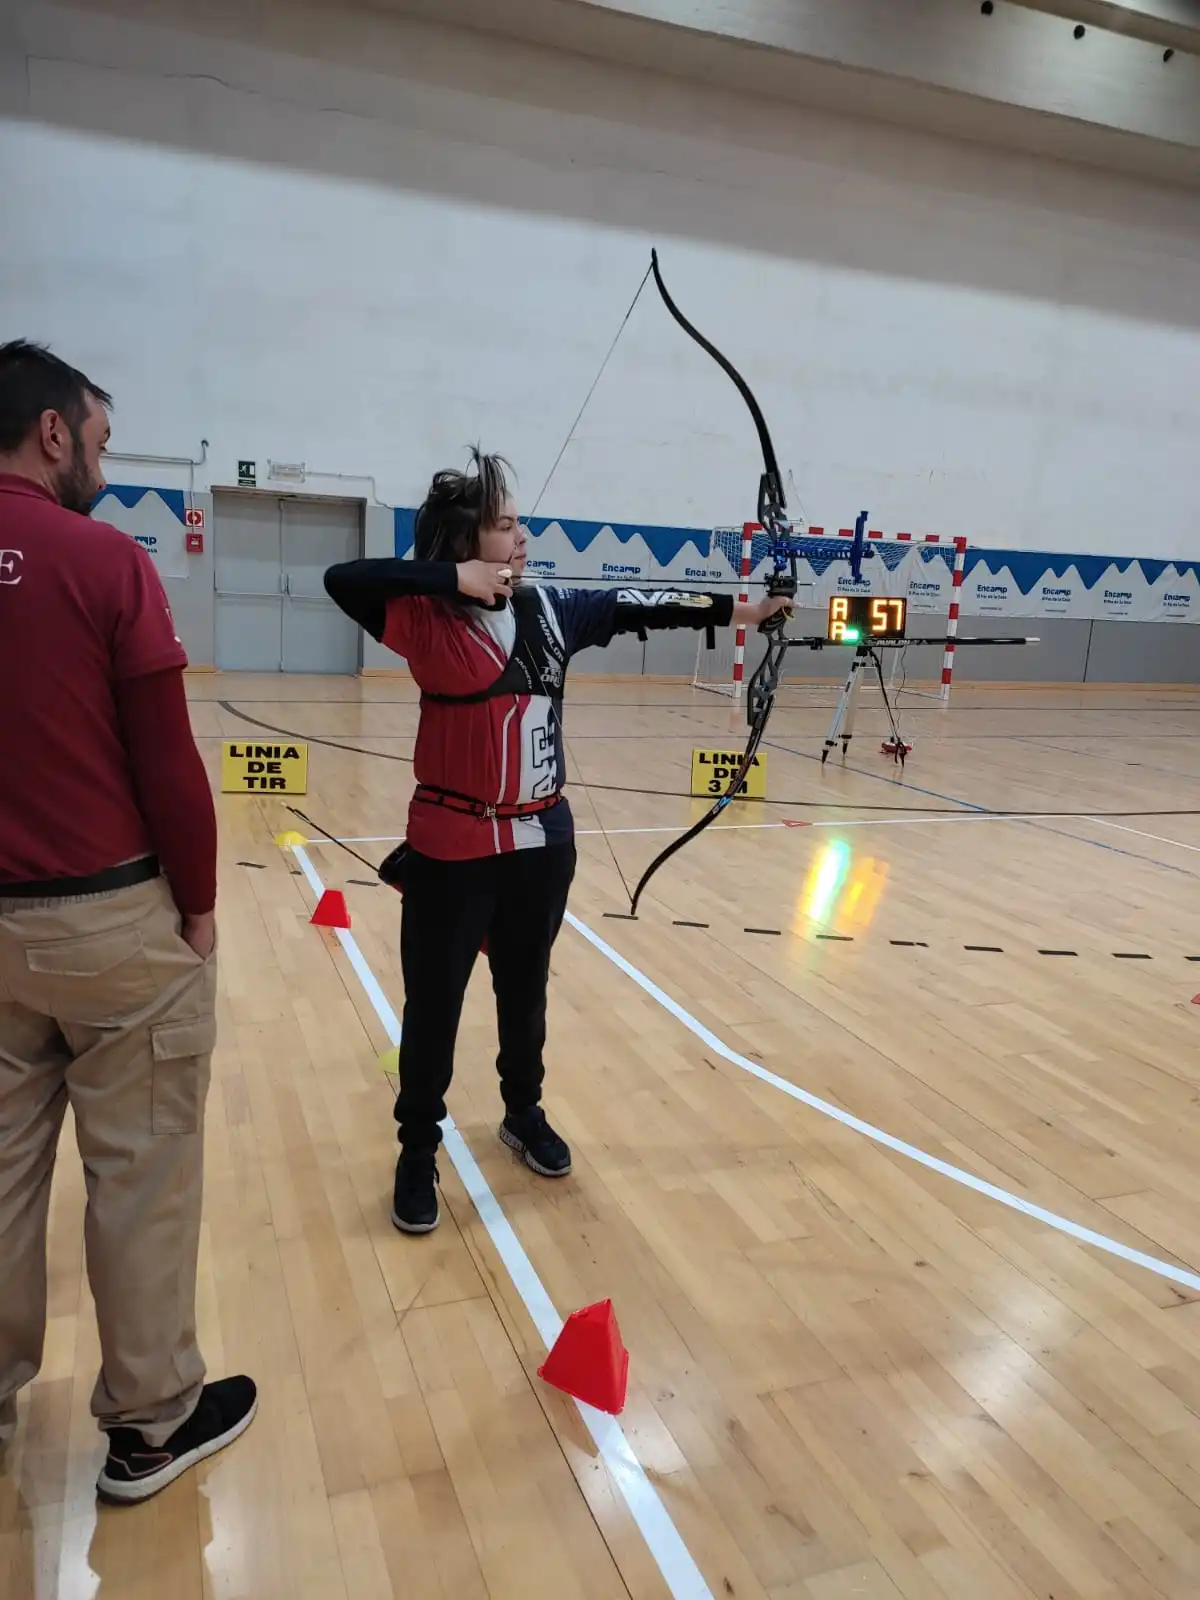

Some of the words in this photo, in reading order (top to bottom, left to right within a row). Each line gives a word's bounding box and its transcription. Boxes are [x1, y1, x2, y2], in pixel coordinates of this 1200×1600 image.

[526, 560, 556, 570] camp
[602, 563, 641, 574] Encamp
[909, 581, 940, 591] Encamp
[977, 585, 1008, 593] Encamp
[1042, 587, 1072, 596] Encamp
[872, 599, 903, 631] 57
[230, 745, 299, 759] LINIA
[247, 761, 282, 774] DE
[243, 776, 286, 789] TIR
[708, 780, 721, 793] 3
